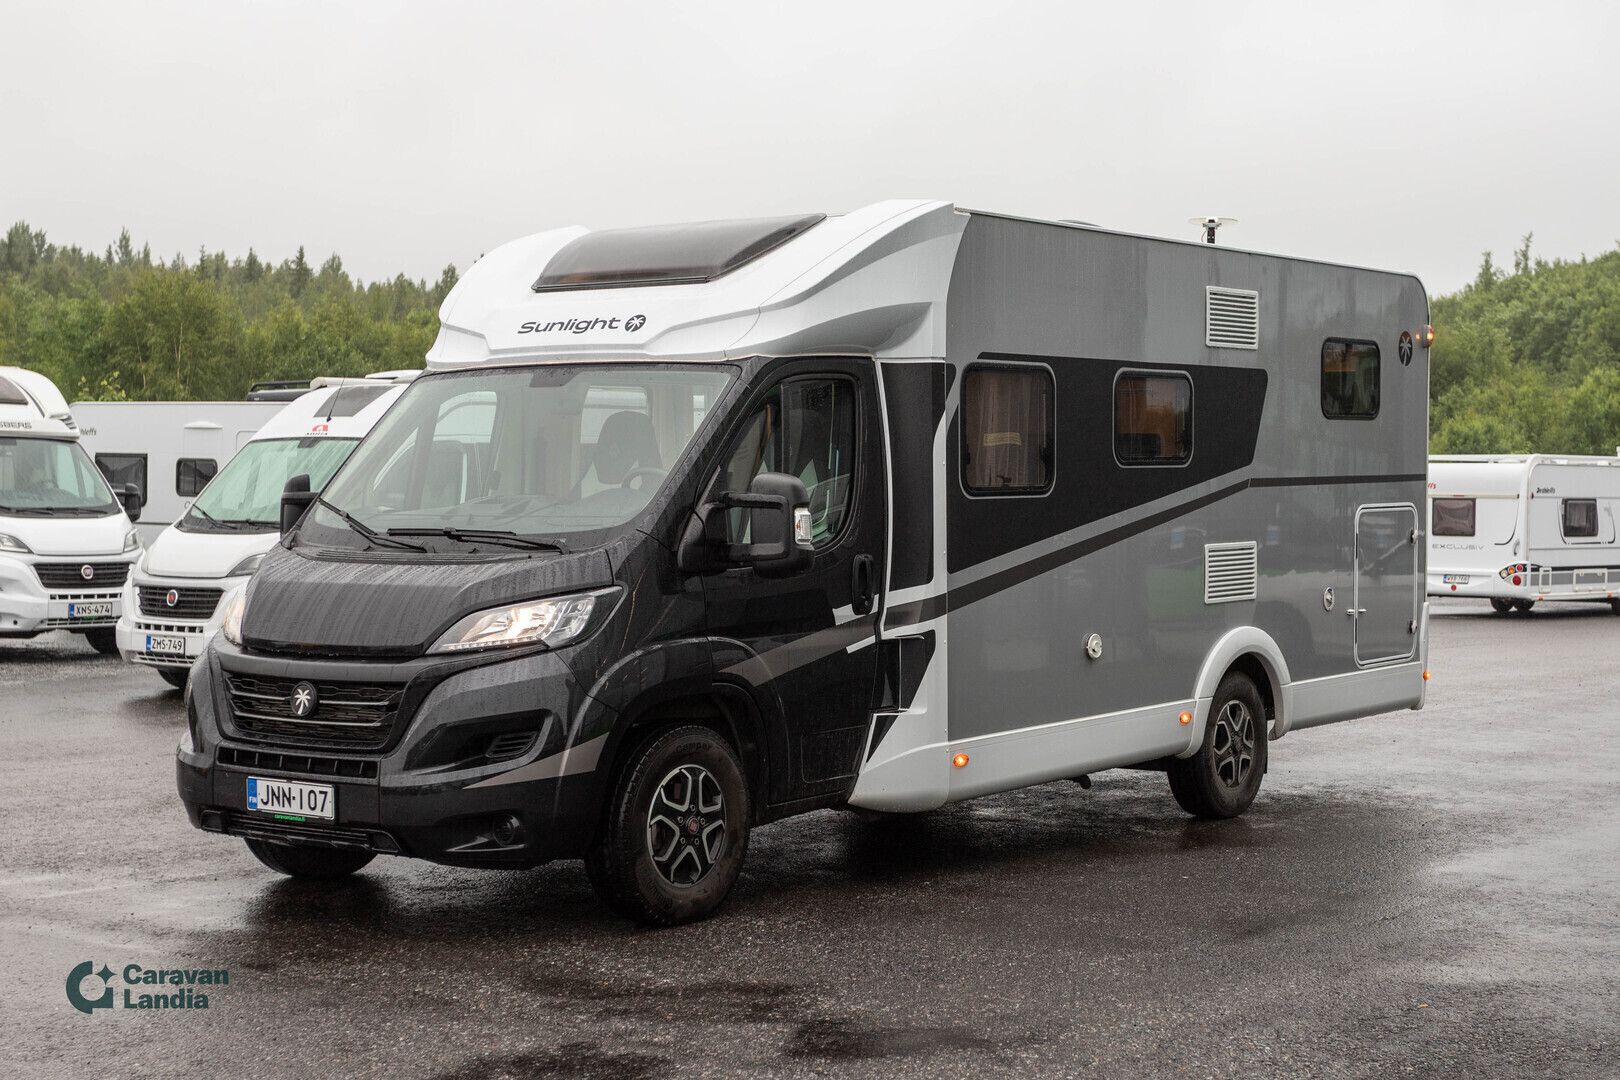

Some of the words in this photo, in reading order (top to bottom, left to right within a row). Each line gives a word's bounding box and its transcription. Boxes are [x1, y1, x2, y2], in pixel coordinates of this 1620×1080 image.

[517, 316, 621, 335] Sunlight
[1432, 543, 1485, 551] EXCLUSIV
[76, 604, 110, 615] XNS-474
[261, 784, 329, 813] JNN-107
